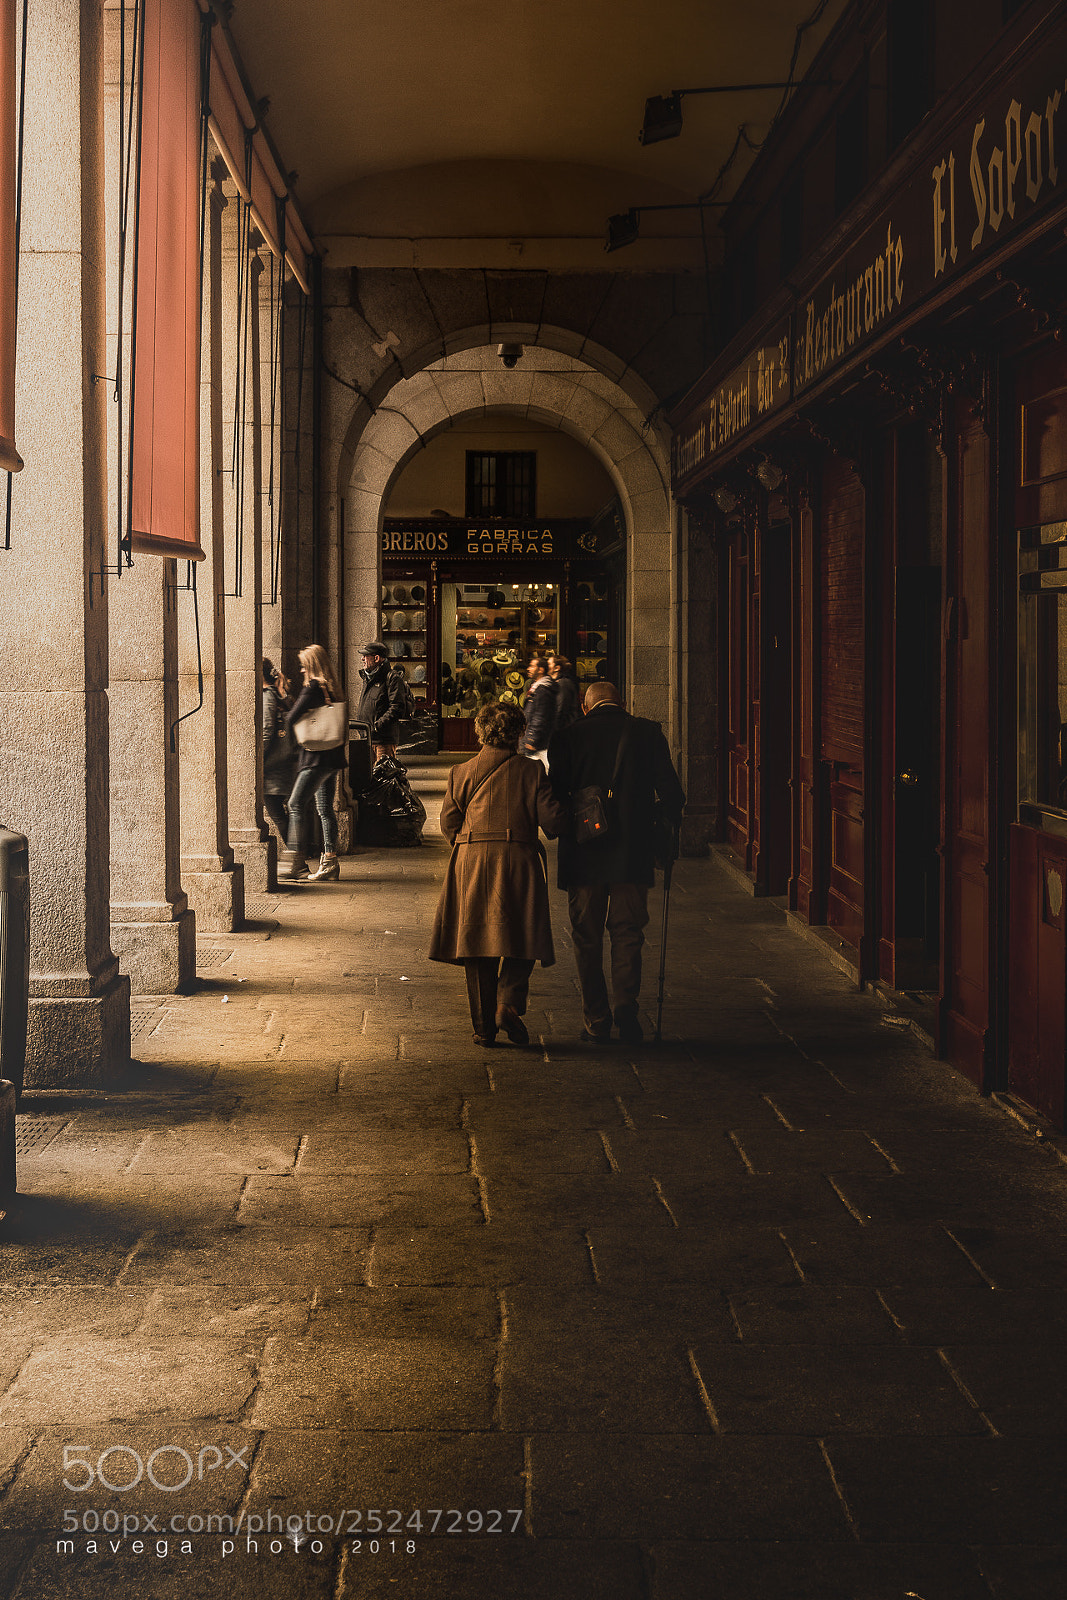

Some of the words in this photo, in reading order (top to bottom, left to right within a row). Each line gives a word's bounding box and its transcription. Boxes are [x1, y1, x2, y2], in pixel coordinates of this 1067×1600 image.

[932, 150, 958, 279] El
[970, 78, 1067, 251] Sopor
[804, 220, 903, 381] Restaurante
[382, 531, 449, 551] BREROS
[467, 529, 553, 540] FABRICA
[467, 543, 553, 553] GORRAS
